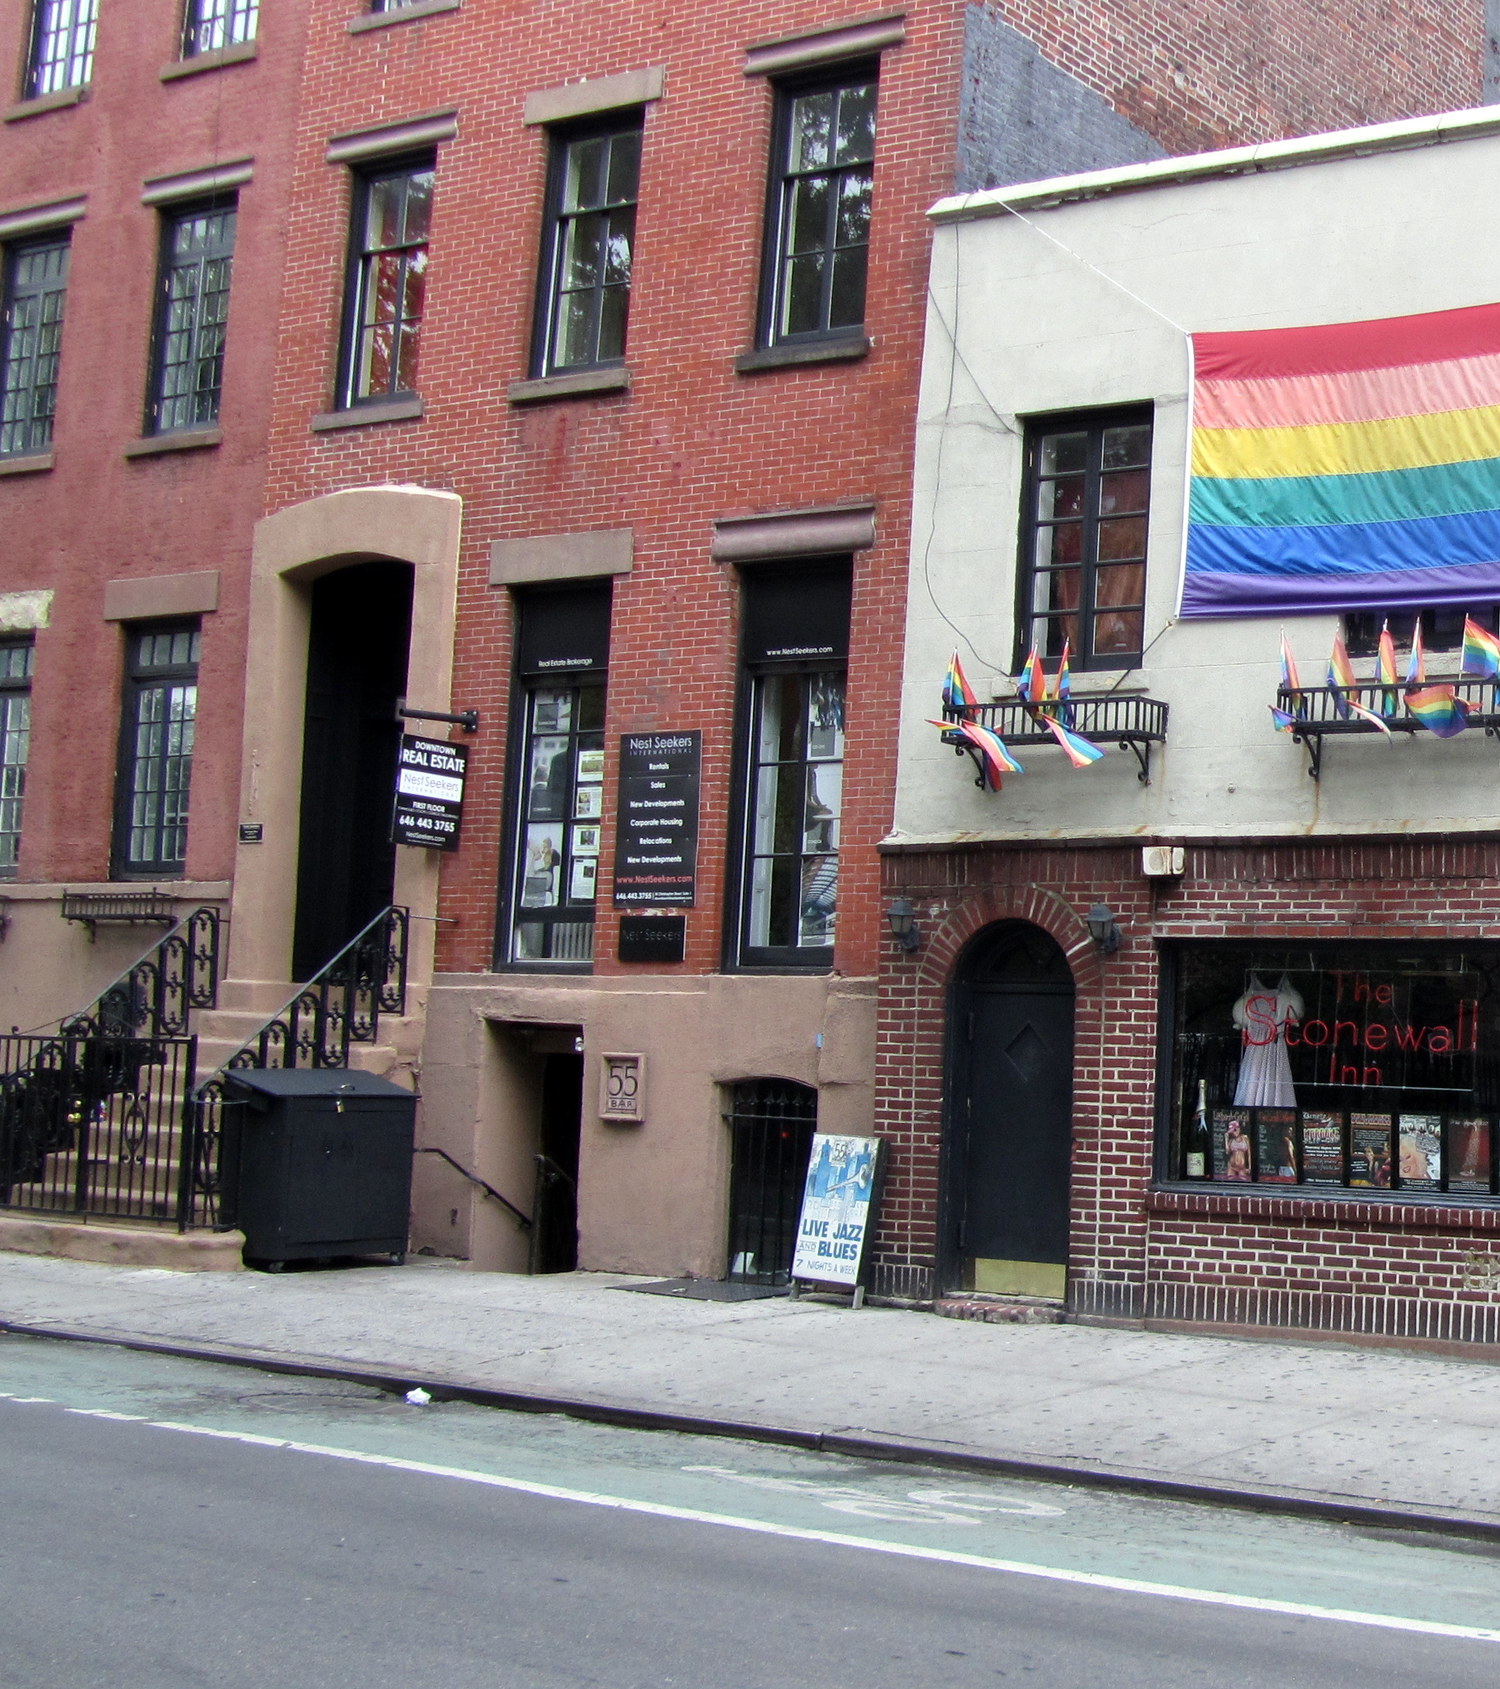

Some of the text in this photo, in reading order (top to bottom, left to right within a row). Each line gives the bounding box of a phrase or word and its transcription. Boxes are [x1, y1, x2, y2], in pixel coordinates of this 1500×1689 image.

[415, 741, 456, 756] DOWNTOWN
[630, 736, 692, 750] Nest Seekers
[629, 748, 692, 756] INTERNATIONAL
[402, 749, 466, 773] REAL ESTATE
[648, 762, 670, 770] Rentals
[650, 781, 666, 789] Sales
[427, 803, 446, 813] FLOOR
[630, 799, 685, 808] New Developments
[399, 815, 456, 833] 646 443 3755
[630, 817, 684, 827] Corporate Housing
[639, 836, 673, 845] Relocations
[627, 855, 682, 864] New Developments
[616, 874, 693, 884] www.NestSeekers.com
[1328, 970, 1394, 1005] The
[1242, 994, 1479, 1053] Stonewall
[1329, 1052, 1384, 1087] Inn
[608, 1065, 638, 1097] 55
[610, 1100, 633, 1108] BAR
[802, 1218, 864, 1243] LIVE JAZZ
[799, 1240, 858, 1261] AND BLUES
[796, 1258, 803, 1269] 7
[806, 1260, 833, 1273] NIGHTS
[839, 1265, 856, 1275] WEEK
